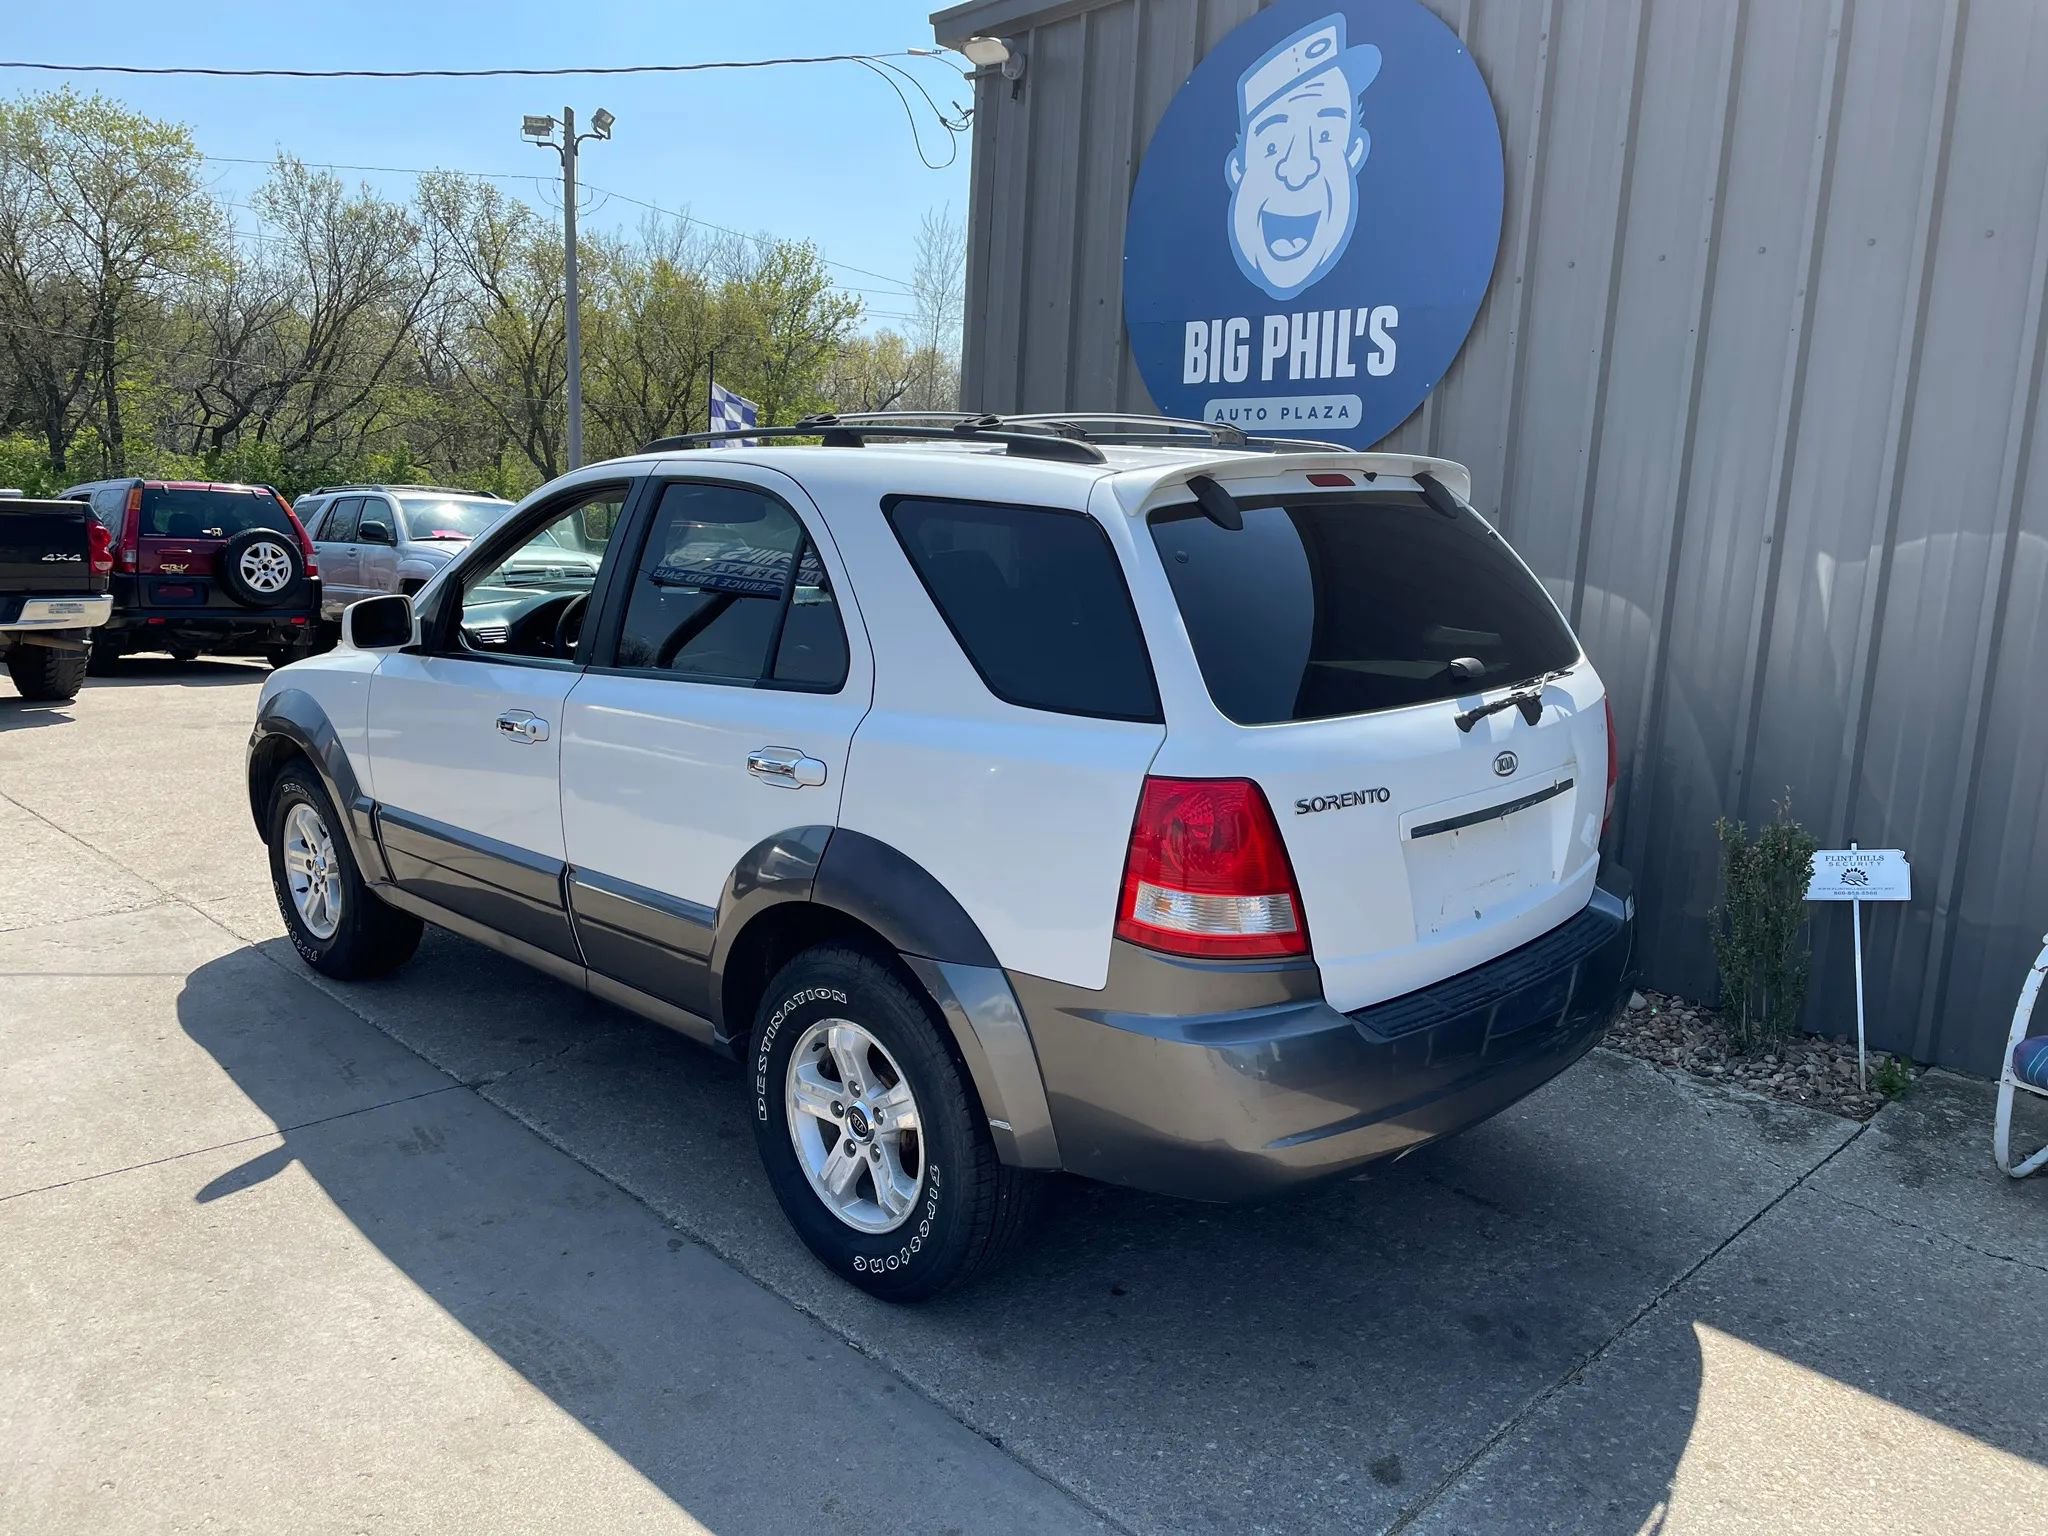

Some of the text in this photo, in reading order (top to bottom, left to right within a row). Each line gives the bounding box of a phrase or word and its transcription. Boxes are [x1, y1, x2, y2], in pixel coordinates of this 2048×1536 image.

[1183, 305, 1399, 384] BIG PHIL'S
[1215, 405, 1350, 421] AUTO PLAZA
[159, 563, 190, 571] CR-V
[1496, 755, 1516, 772] KIA
[1295, 787, 1391, 816] SORENTO
[757, 987, 848, 1121] DESTINATION
